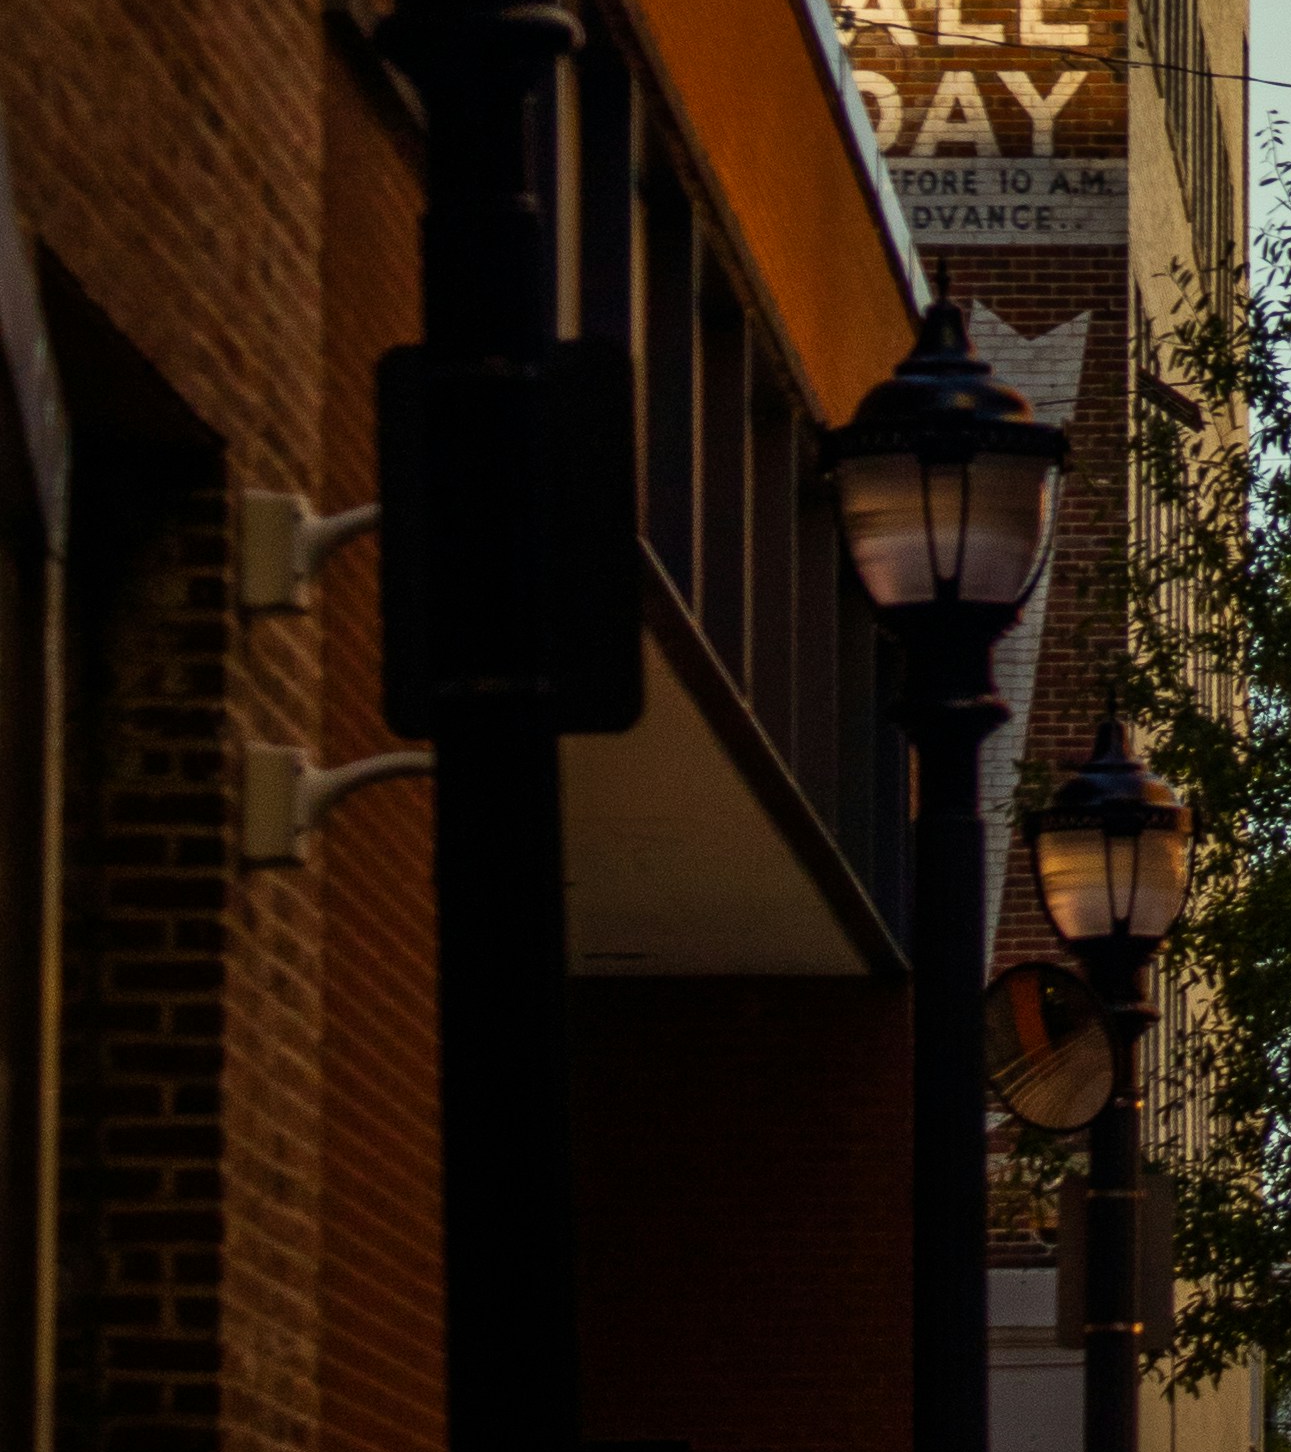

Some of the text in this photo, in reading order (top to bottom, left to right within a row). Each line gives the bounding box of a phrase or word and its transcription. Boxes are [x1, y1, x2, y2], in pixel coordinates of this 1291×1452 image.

[889, 169, 1113, 196] FORE 10 A.M.
[911, 205, 1083, 232] DVANCE..
